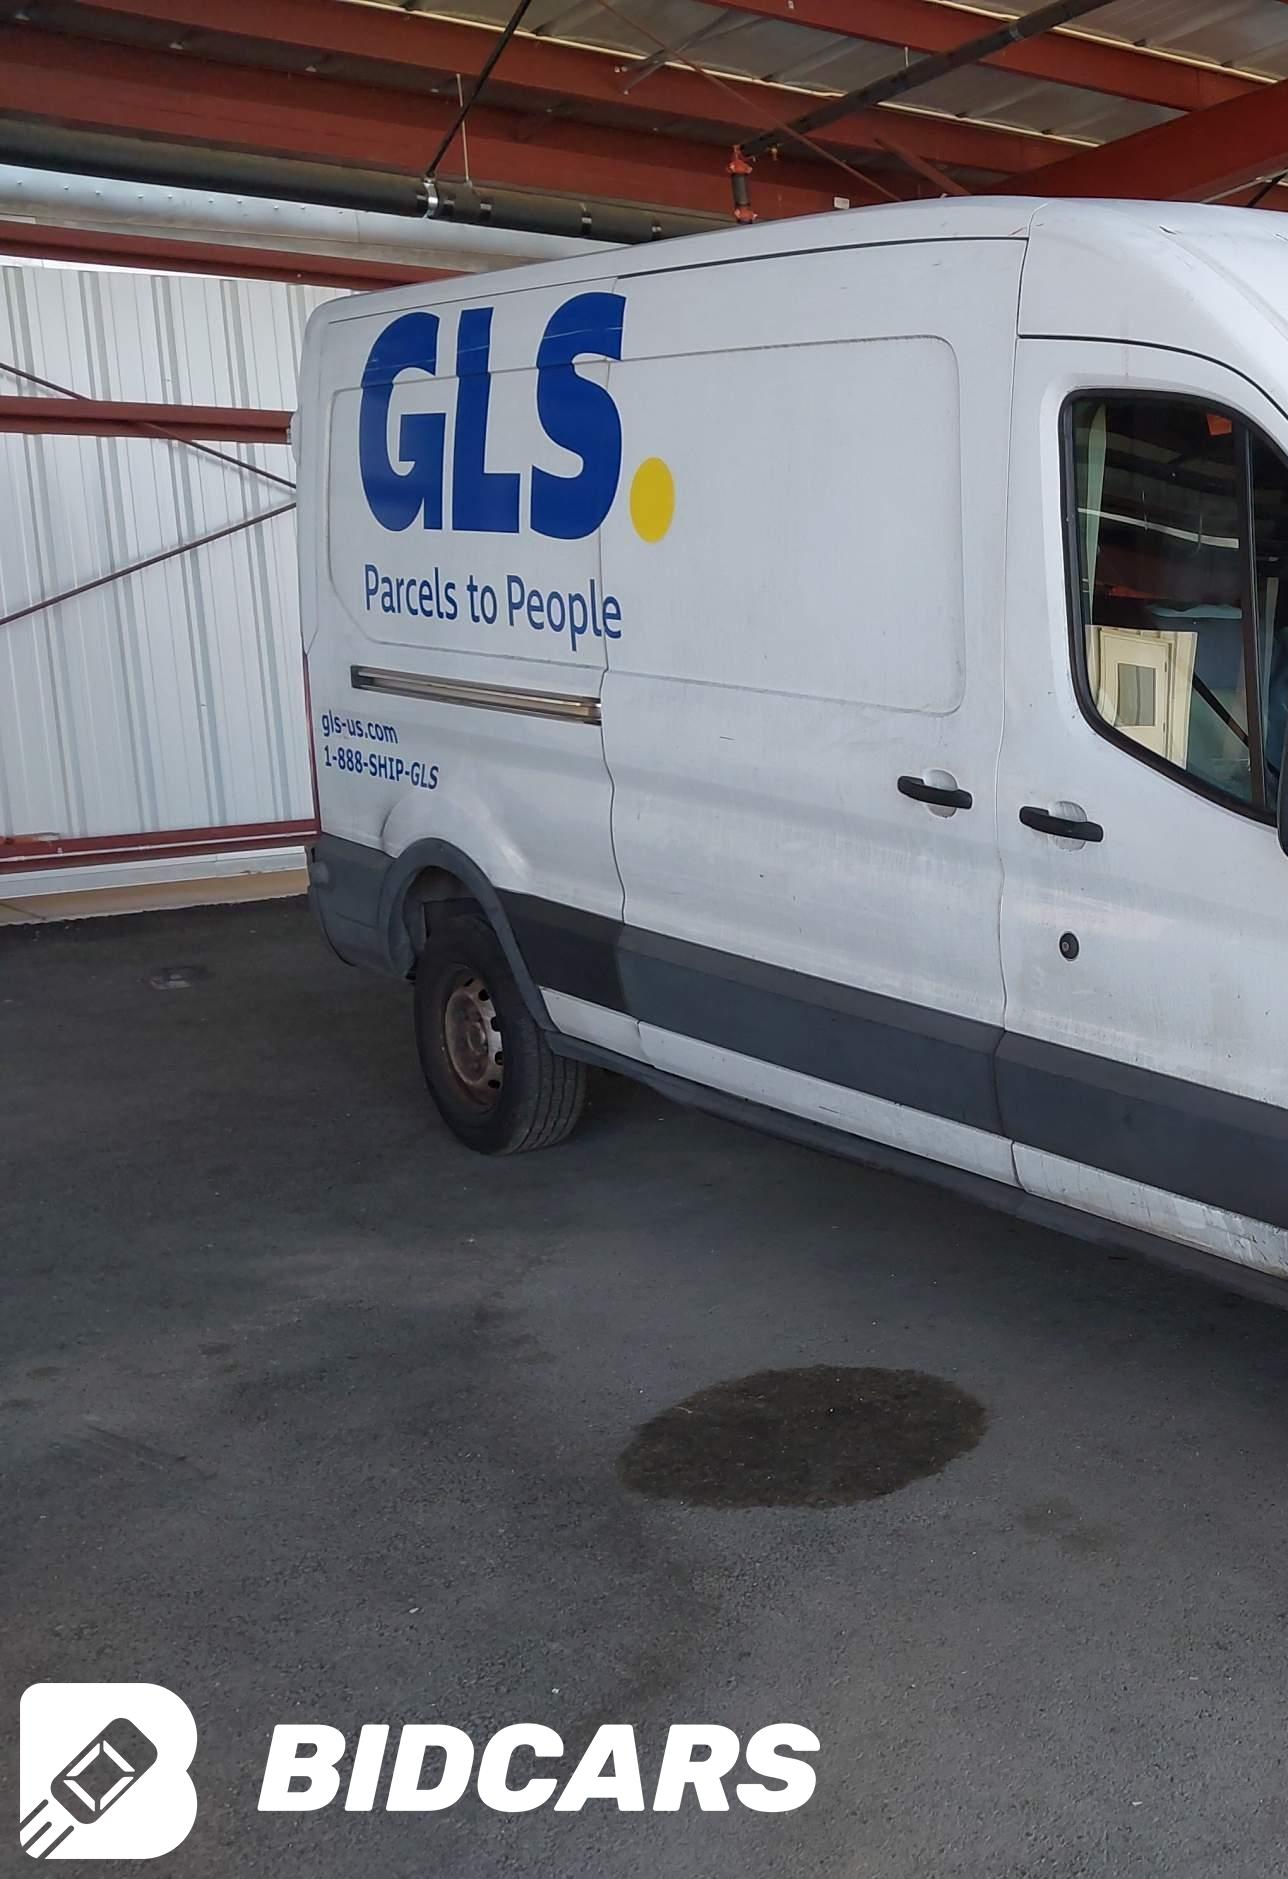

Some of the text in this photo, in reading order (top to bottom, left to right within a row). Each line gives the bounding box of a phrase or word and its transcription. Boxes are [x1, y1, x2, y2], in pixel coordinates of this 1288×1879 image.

[364, 563, 622, 652] Parcels to People
[321, 709, 399, 744] gls-us.com
[323, 745, 439, 790] 1-888-SHIP-GLS
